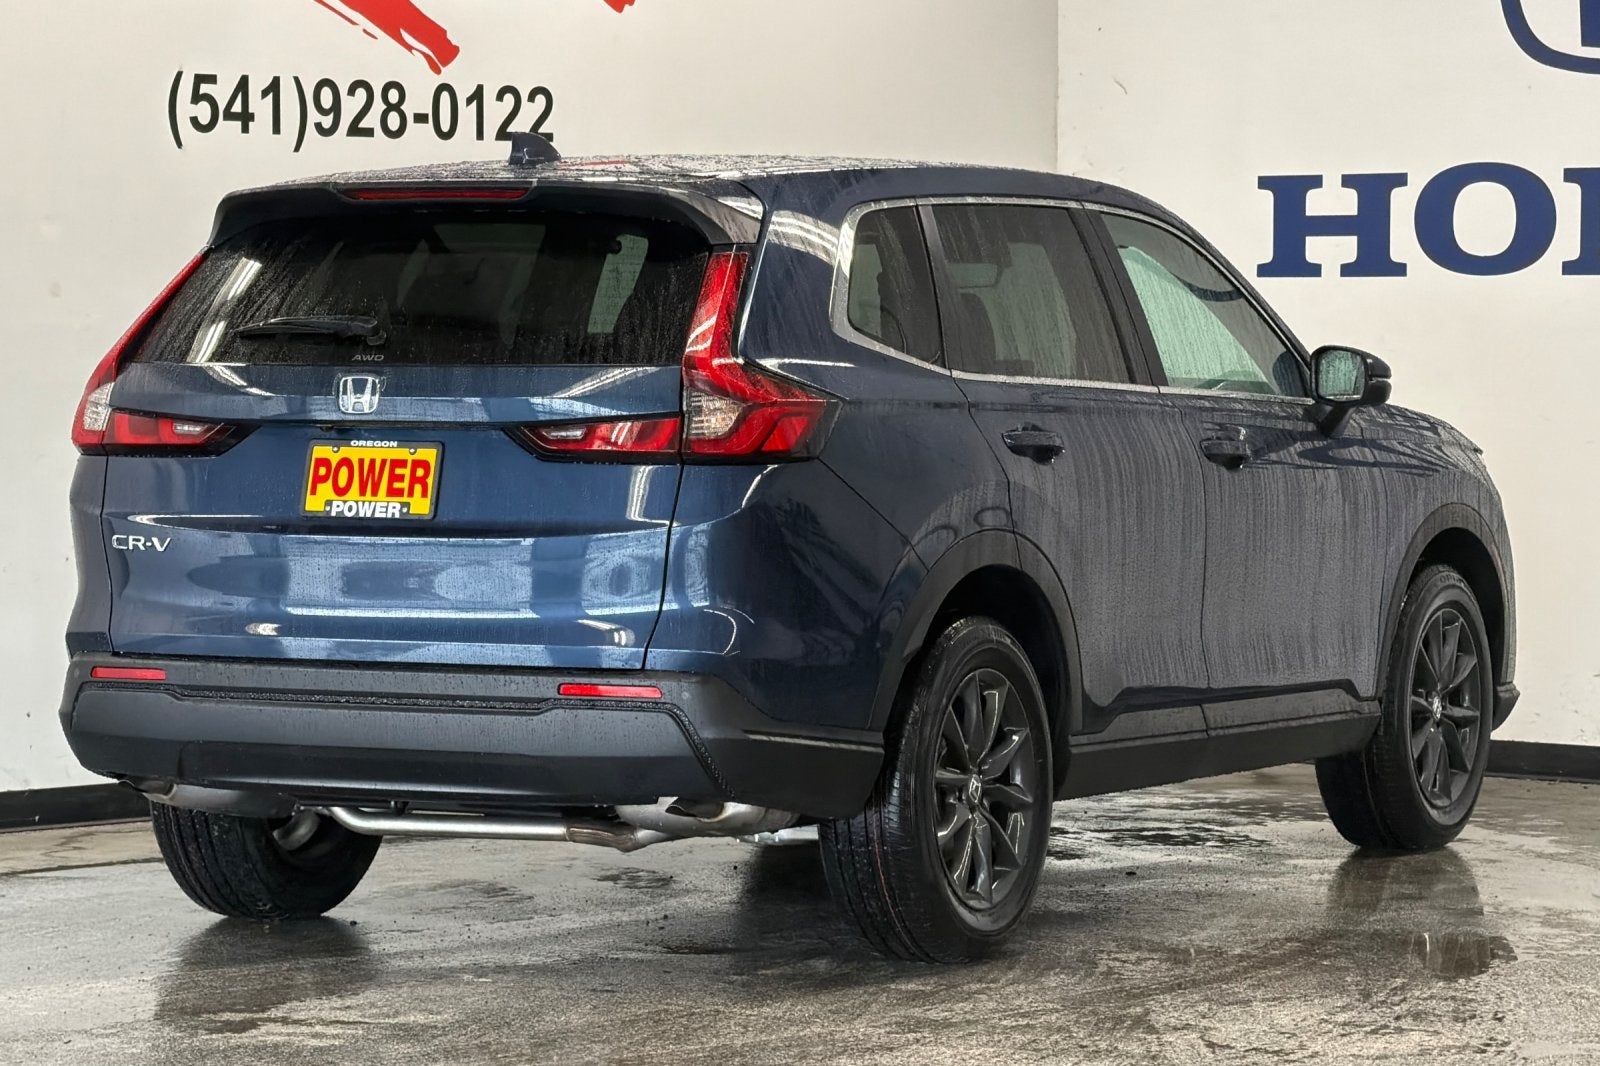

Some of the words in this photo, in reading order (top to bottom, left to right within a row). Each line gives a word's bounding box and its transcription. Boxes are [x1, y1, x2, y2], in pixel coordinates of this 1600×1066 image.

[168, 70, 554, 153] (541)928-0122
[1256, 161, 1600, 278] HO
[350, 440, 398, 448] OREGON
[310, 457, 431, 498] POWER
[331, 500, 401, 518] POWER
[111, 534, 171, 552] CR-V
